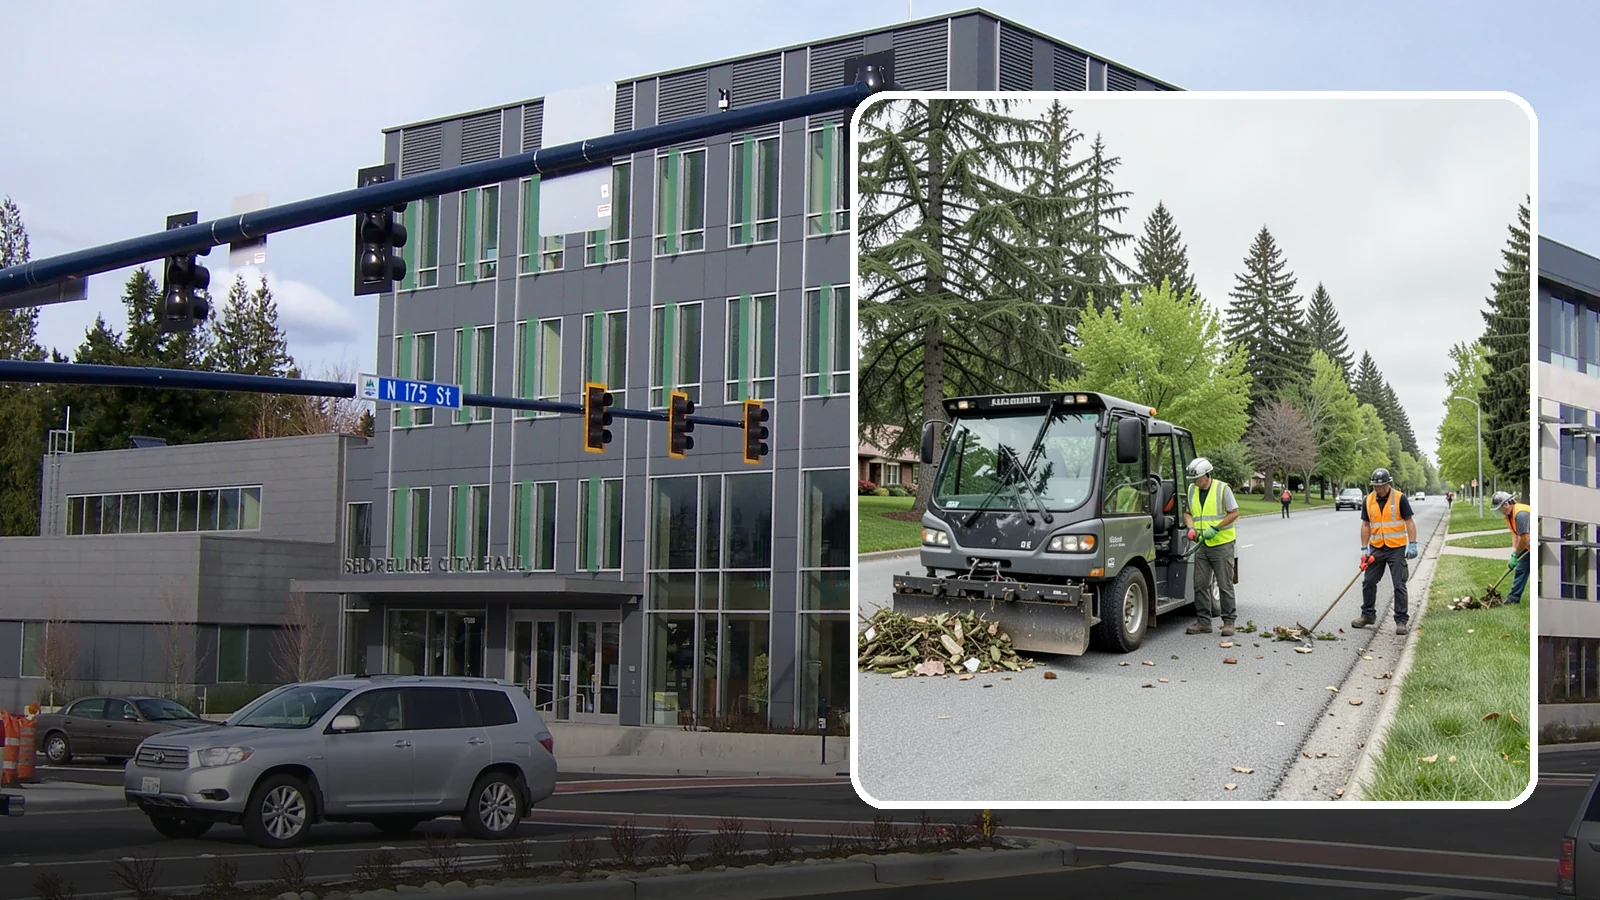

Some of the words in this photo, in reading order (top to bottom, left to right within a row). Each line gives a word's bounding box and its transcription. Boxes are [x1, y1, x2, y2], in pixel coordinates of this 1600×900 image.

[387, 380, 396, 400] N
[405, 382, 428, 403] 175
[436, 386, 452, 406] St
[344, 556, 432, 574] SHORELINE
[438, 556, 475, 573] CITY
[483, 555, 526, 572] HALL
